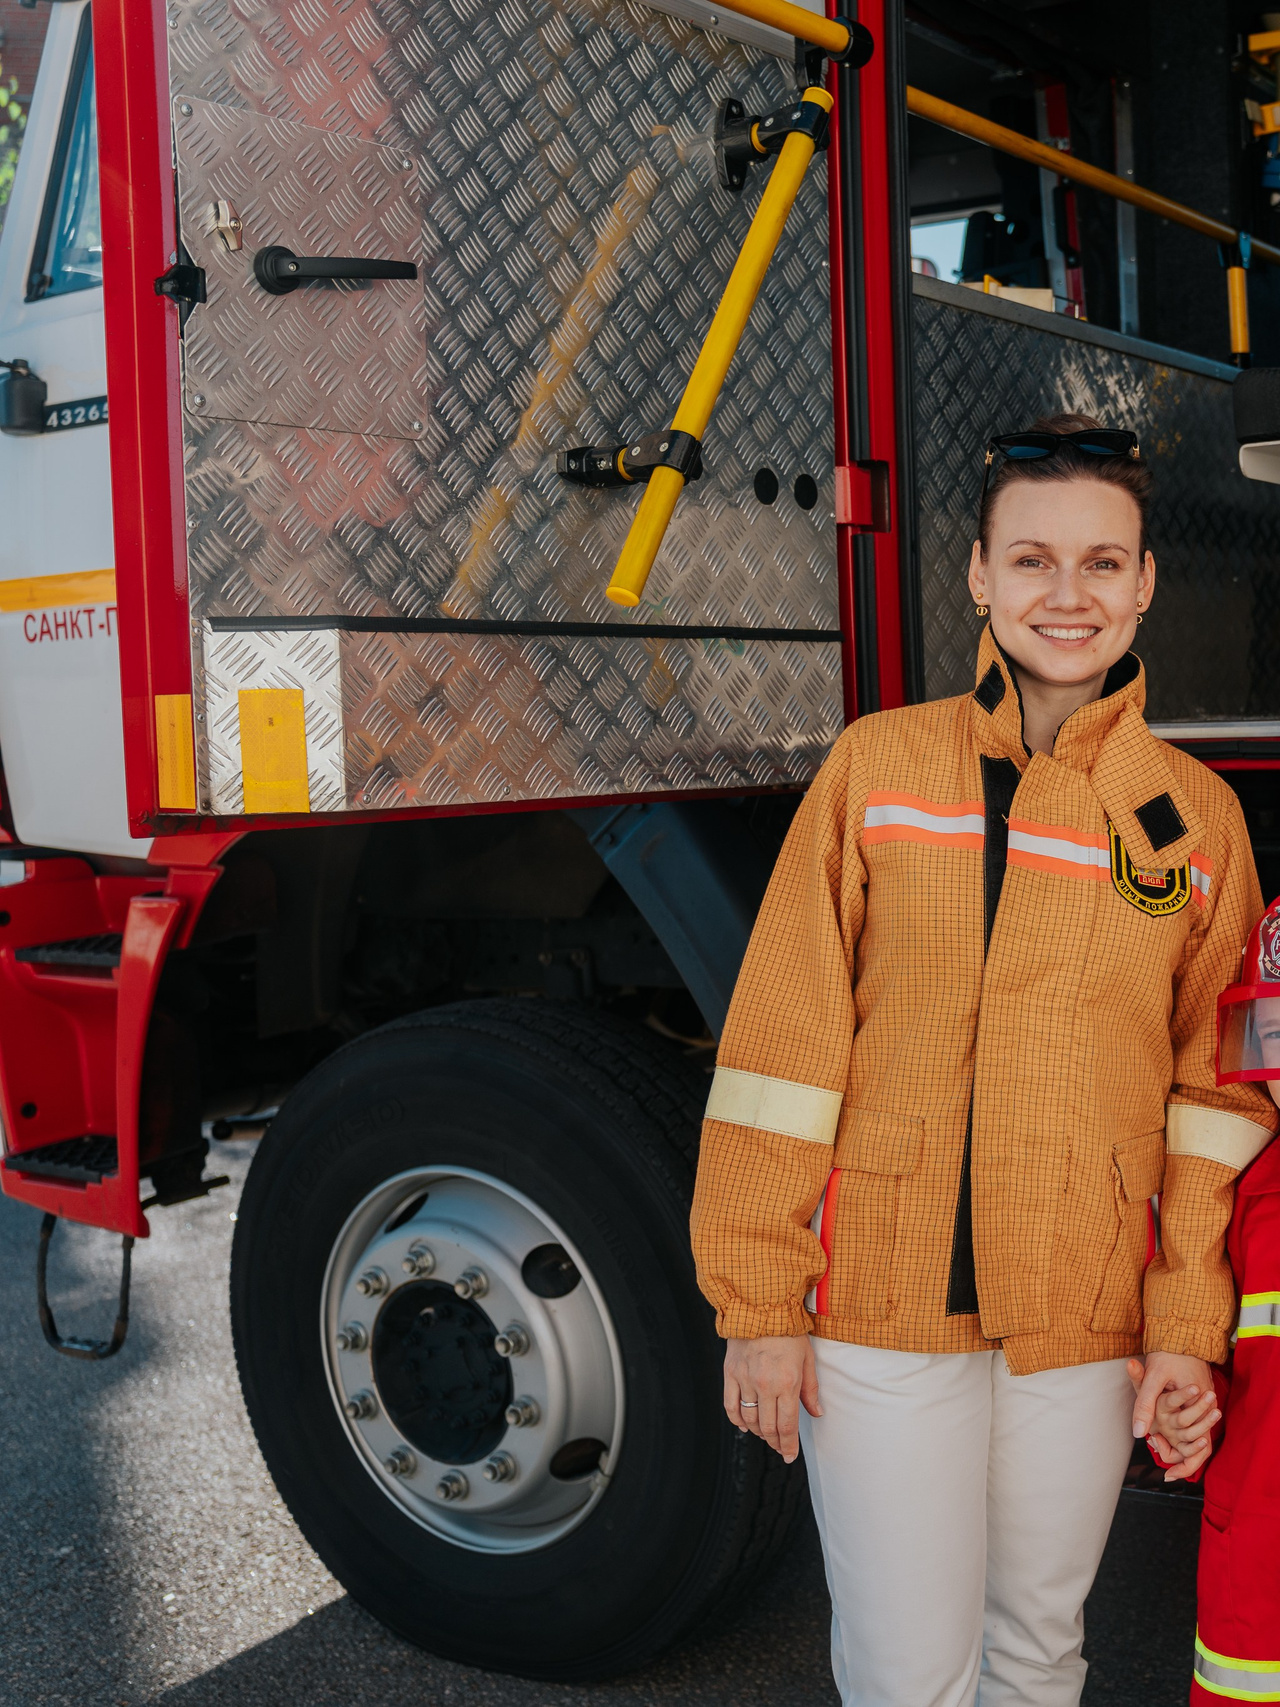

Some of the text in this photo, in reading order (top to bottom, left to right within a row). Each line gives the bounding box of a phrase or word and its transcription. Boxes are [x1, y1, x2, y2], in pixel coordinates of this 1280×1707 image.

[1142, 876, 1161, 885] ДЮП
[1118, 879, 1187, 911] ЮНЫЙ ПОЖАРНЫЙ
